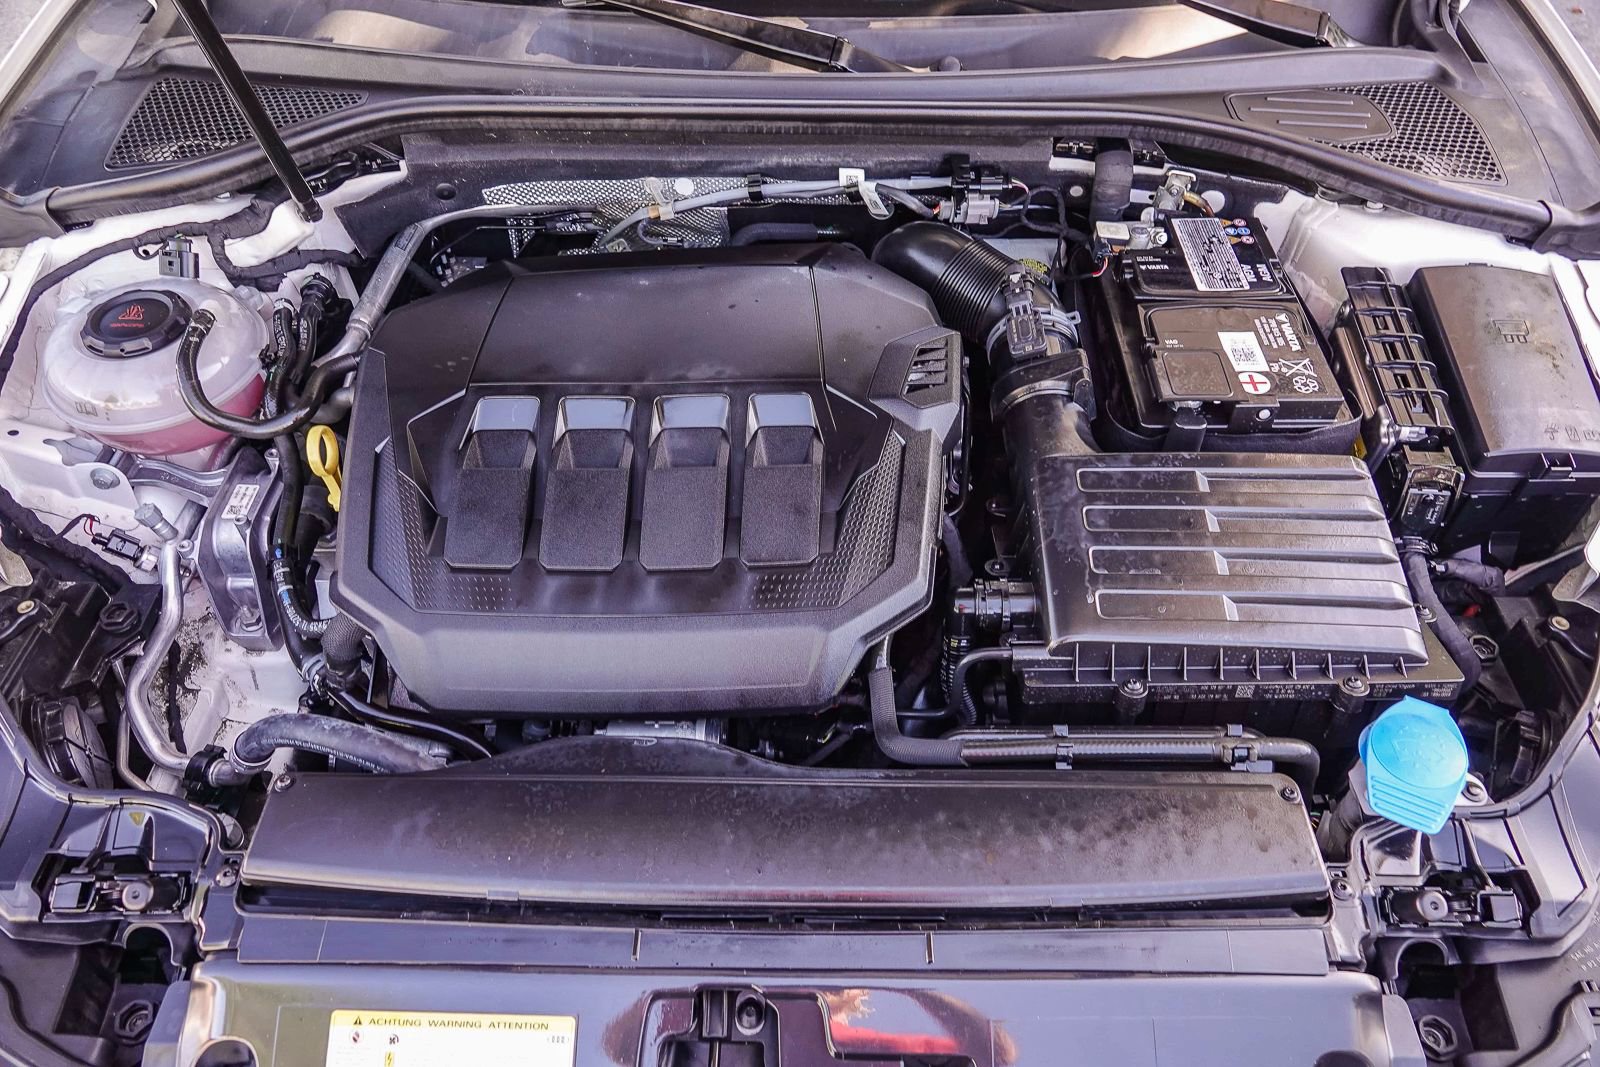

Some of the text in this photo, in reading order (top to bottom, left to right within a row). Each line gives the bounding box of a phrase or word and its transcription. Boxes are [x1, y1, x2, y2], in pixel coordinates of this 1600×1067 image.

[1241, 264, 1257, 283] AGM
[1257, 263, 1273, 283] AGM
[1280, 322, 1302, 352] VARTA
[368, 1017, 549, 1031] ACHTUNG WARNING ATTENTION
